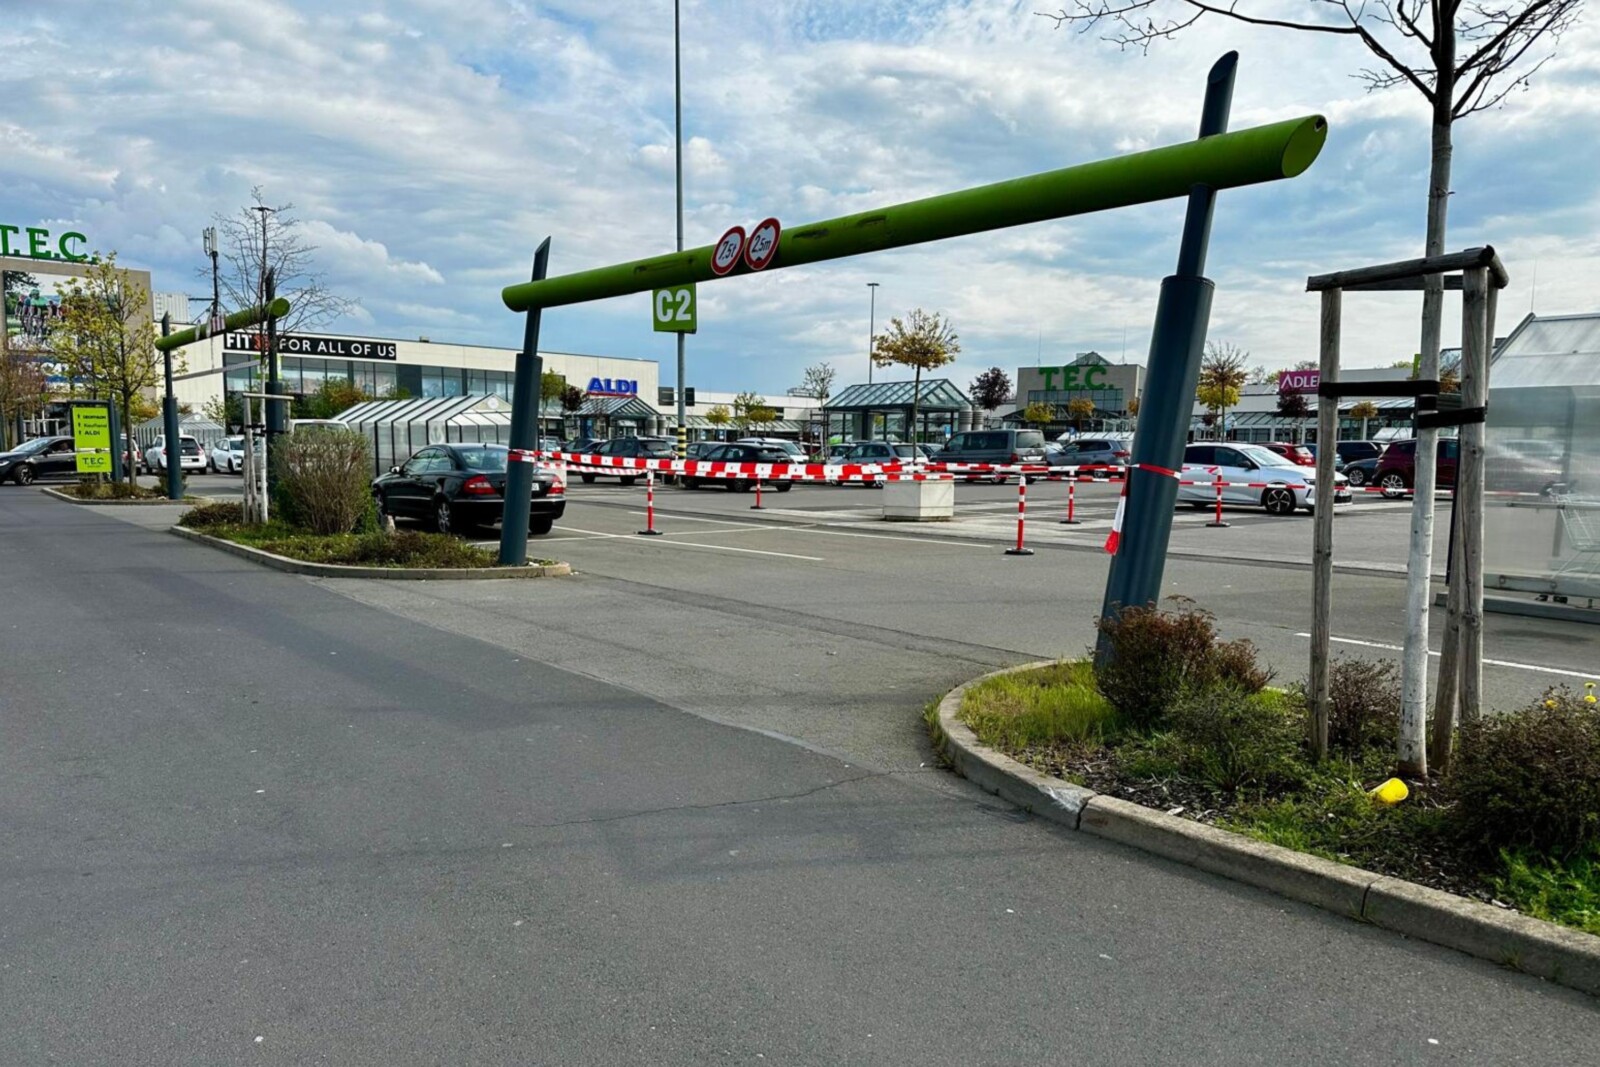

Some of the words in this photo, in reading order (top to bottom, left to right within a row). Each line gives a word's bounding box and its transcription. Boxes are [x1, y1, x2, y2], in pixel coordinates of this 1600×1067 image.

[656, 289, 691, 322] C2
[279, 338, 311, 352] FOR
[317, 341, 345, 354] ALL
[351, 343, 371, 355] OF
[377, 345, 396, 357] US
[587, 377, 637, 394] ALDI
[1280, 373, 1320, 389] ADLE
